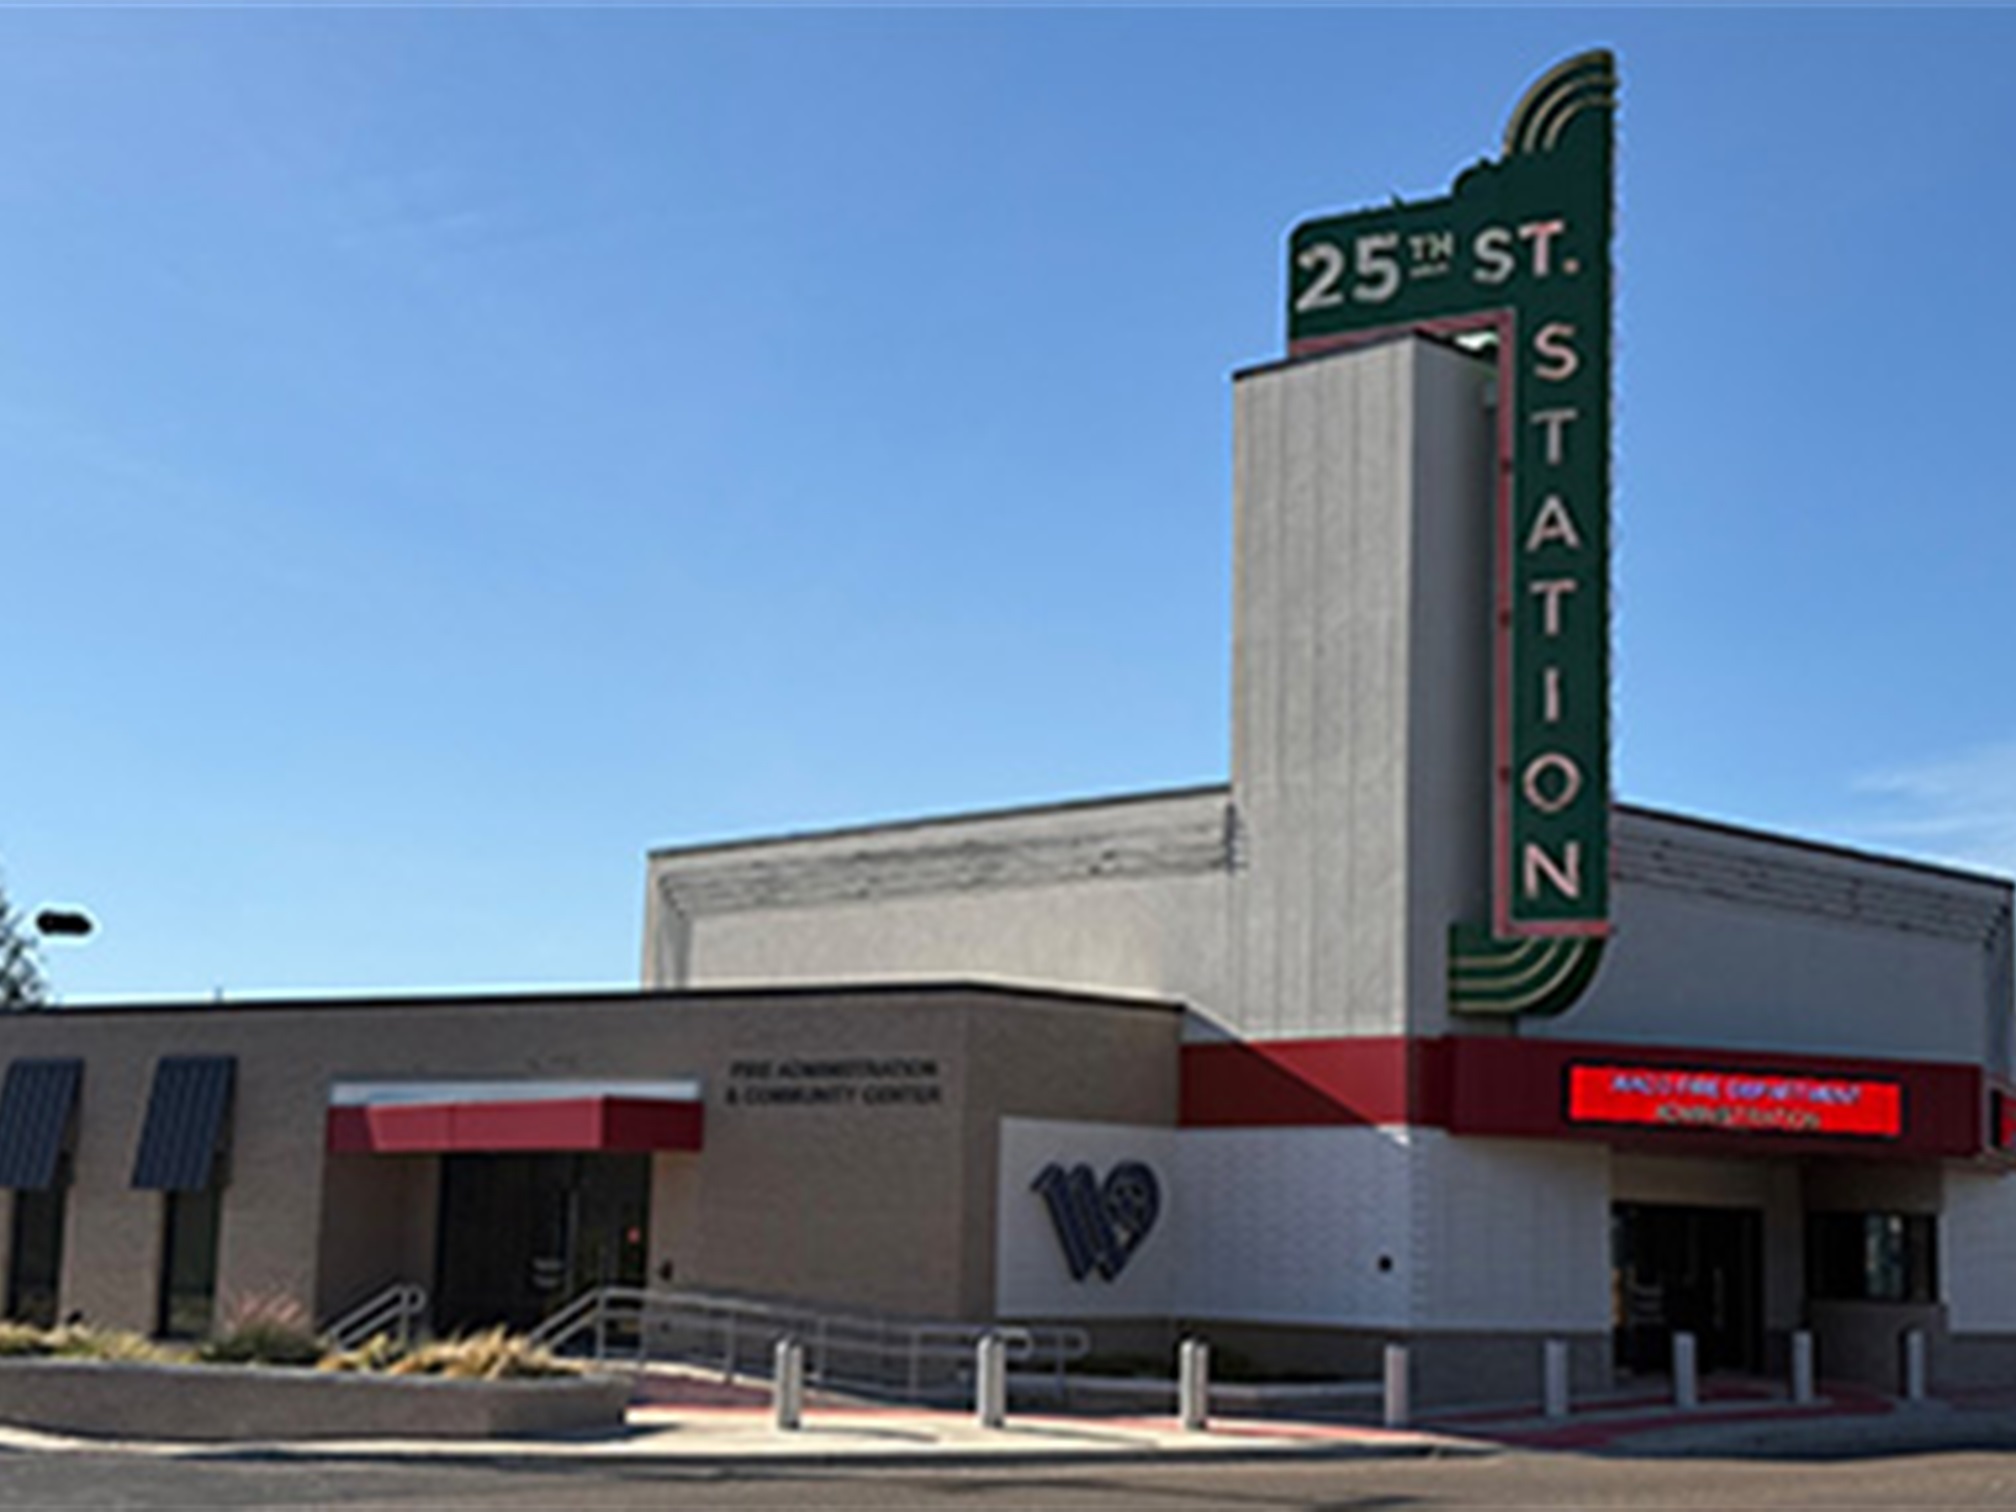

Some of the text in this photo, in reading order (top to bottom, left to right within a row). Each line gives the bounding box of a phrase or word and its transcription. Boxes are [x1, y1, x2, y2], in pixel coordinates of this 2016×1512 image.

[1472, 219, 1581, 284] ST.
[1523, 322, 1582, 898] STATION
[744, 1083, 857, 1105] COMMUNITY
[862, 1082, 941, 1104] CENTER
